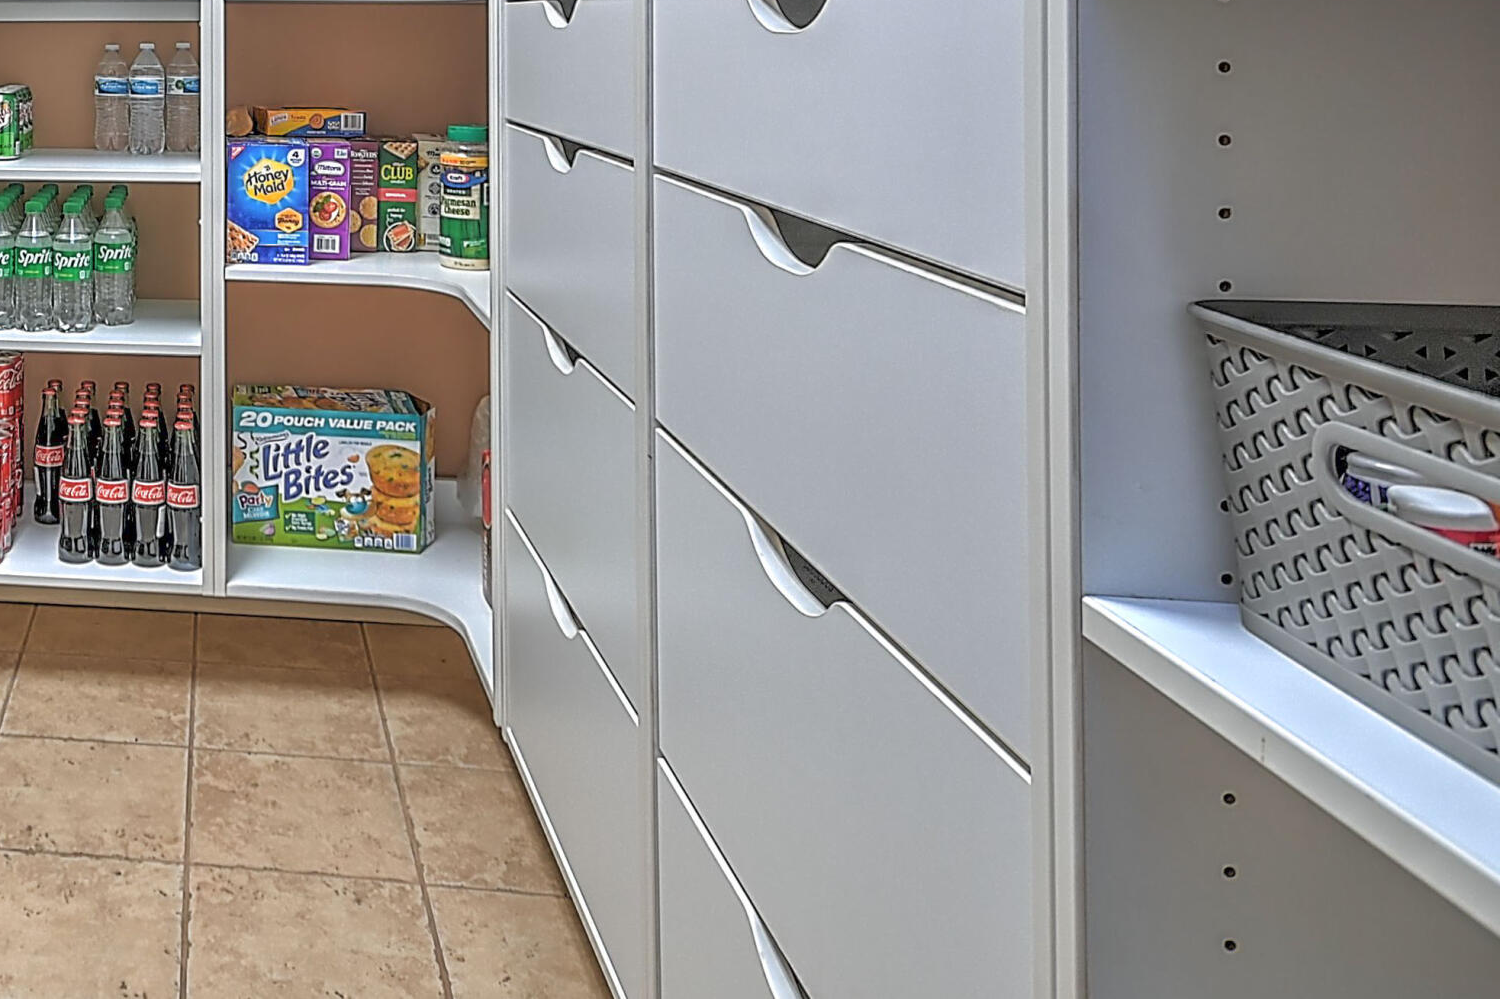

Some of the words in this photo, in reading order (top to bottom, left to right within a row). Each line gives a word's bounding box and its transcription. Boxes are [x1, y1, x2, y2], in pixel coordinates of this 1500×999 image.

[247, 169, 290, 188] Honey
[381, 164, 414, 181] CLUB
[253, 181, 286, 197] Maid
[444, 206, 471, 216] Cheese
[17, 250, 51, 267] Sprit
[54, 252, 91, 269] Sprite
[98, 245, 132, 262] Sprite
[239, 411, 273, 428] 20
[273, 415, 325, 428] POUCH
[328, 418, 373, 430] VALUE
[376, 420, 417, 433] PACK
[35, 448, 62, 463] Coca-Cola
[262, 434, 330, 481] Little
[59, 483, 88, 498] Coca-Cola
[97, 484, 126, 499] Coca-Cola
[134, 484, 164, 499] Coca-Cola
[283, 464, 355, 502] Bites
[237, 491, 273, 509] Party
